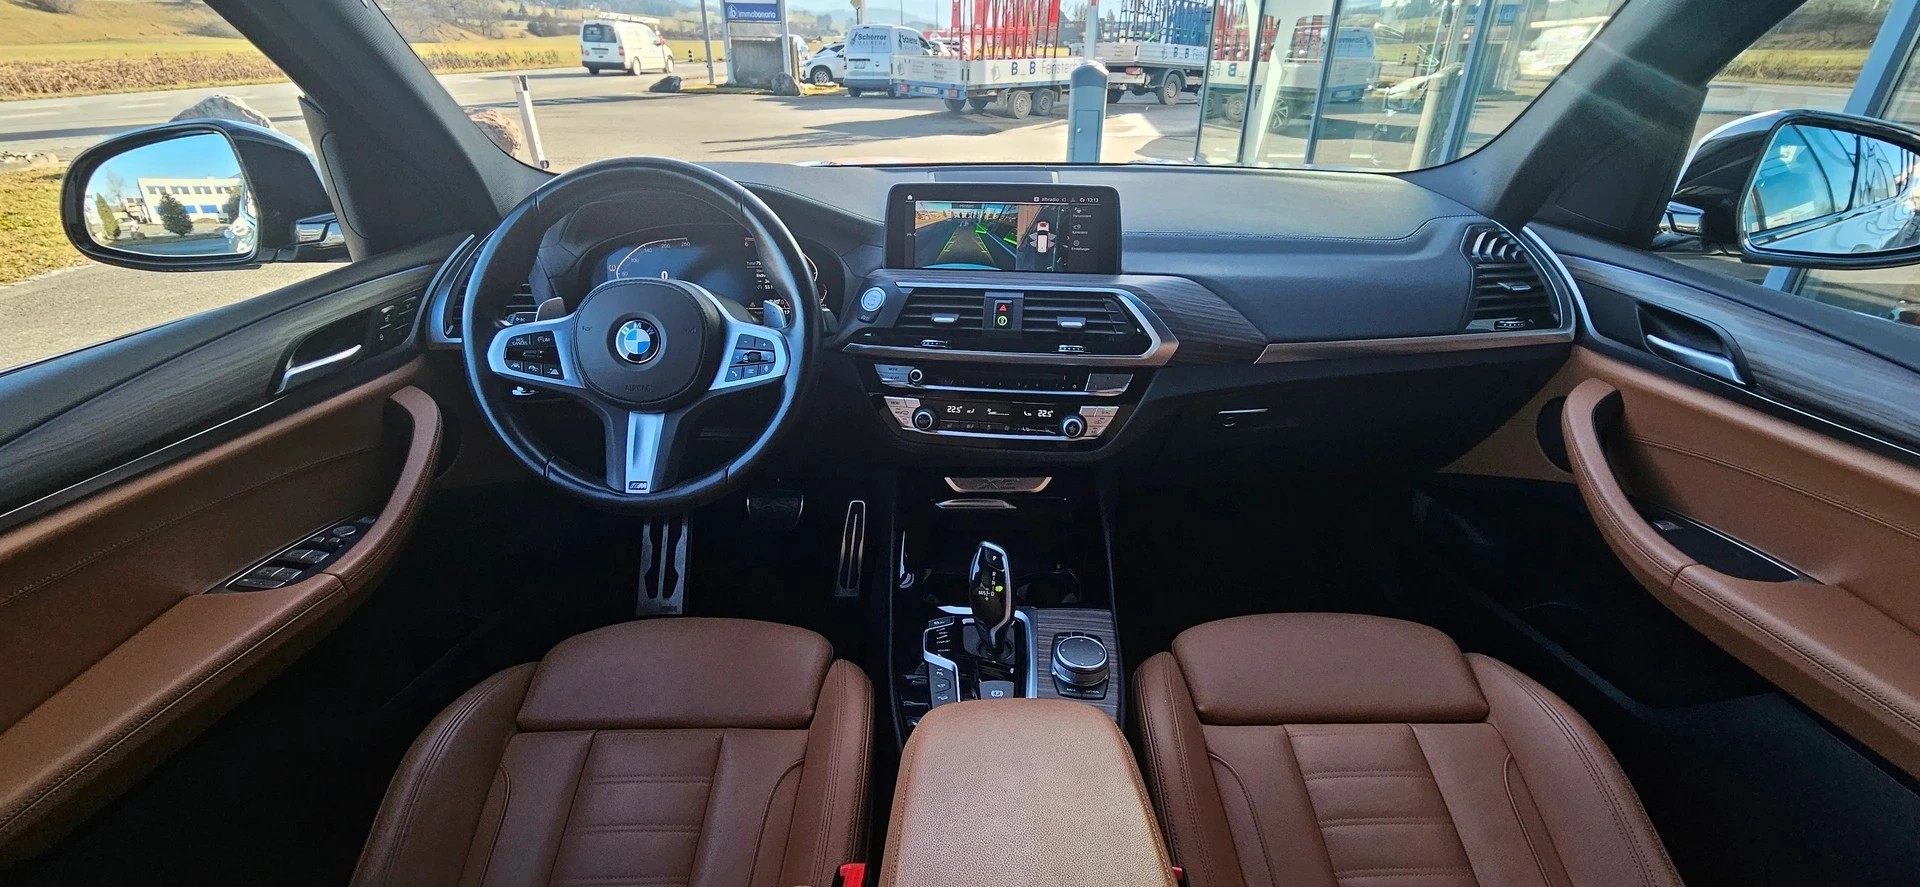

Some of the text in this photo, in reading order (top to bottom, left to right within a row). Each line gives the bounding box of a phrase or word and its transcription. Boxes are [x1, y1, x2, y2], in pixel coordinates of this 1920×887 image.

[1011, 61, 1018, 75] B
[1029, 61, 1036, 75] B
[661, 270, 669, 280] 0
[621, 321, 656, 336] BMW
